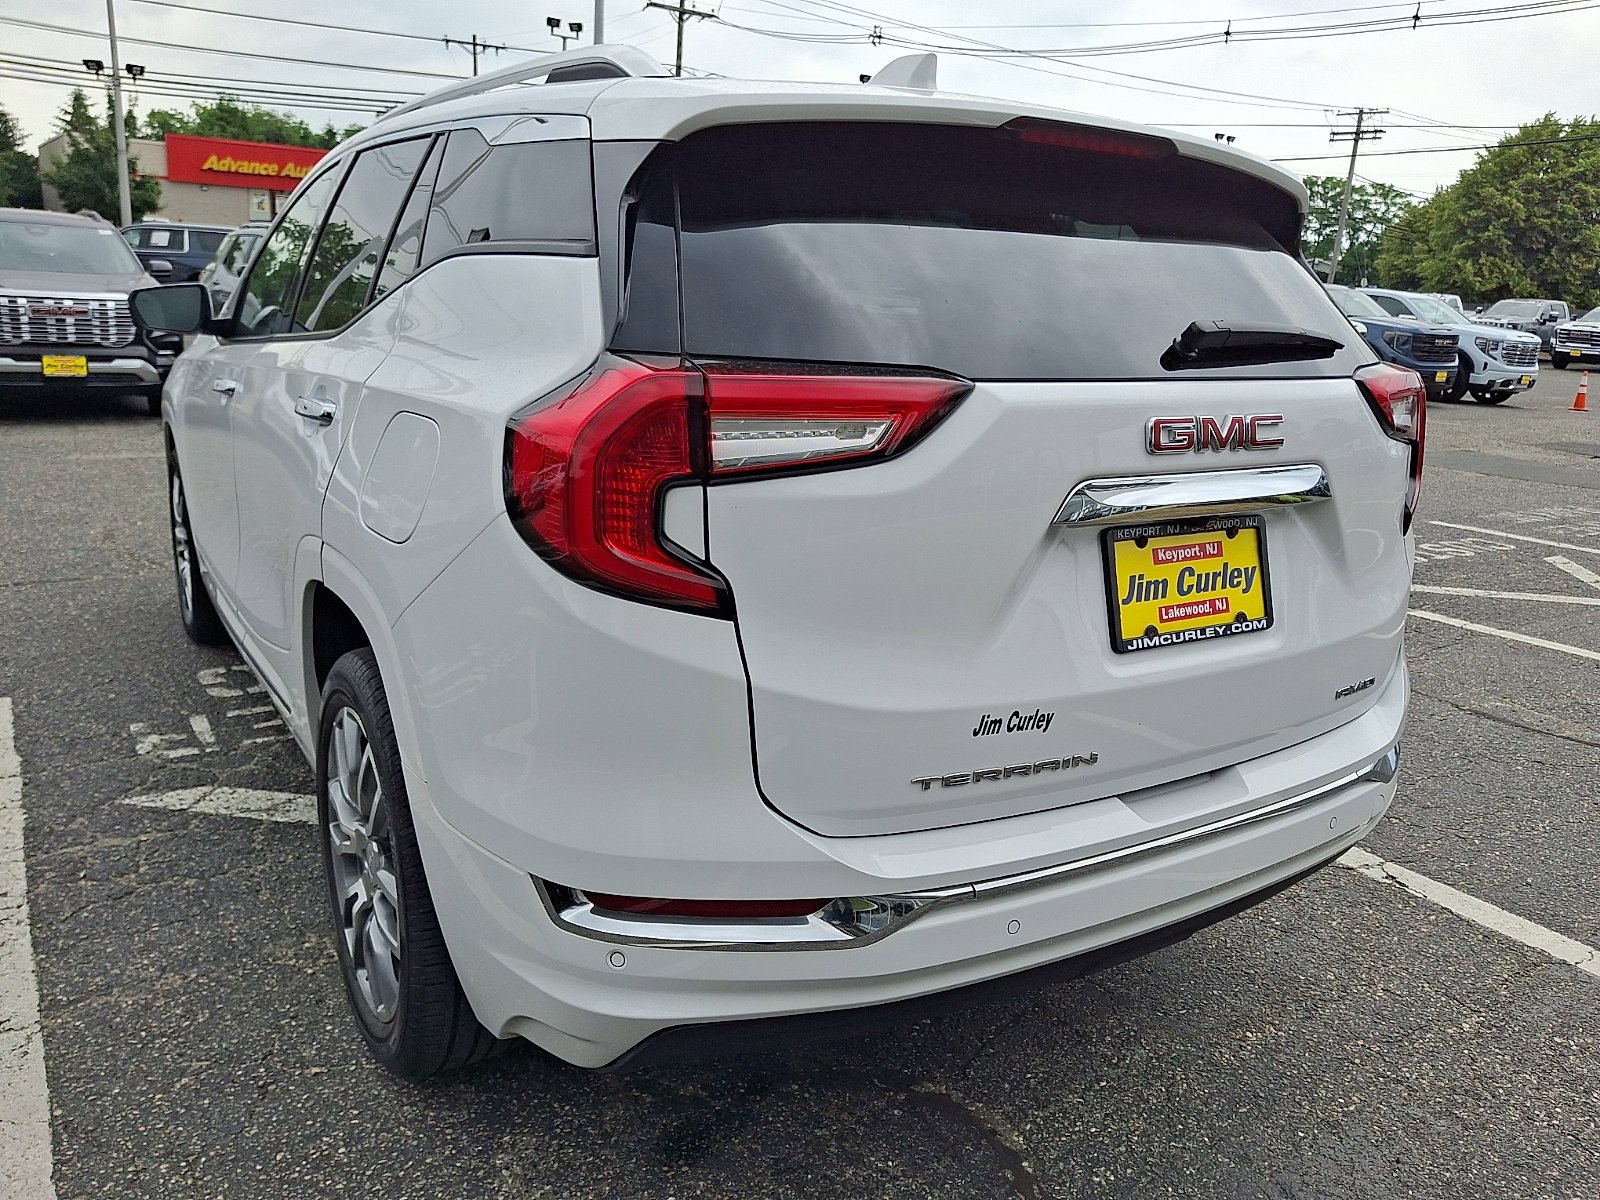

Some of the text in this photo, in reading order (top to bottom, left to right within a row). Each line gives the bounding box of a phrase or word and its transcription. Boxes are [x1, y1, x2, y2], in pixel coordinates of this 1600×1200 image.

[200, 155, 279, 176] Advance
[1145, 412, 1285, 455] GMC
[1117, 525, 1165, 539] KEYPORT,
[1167, 524, 1181, 534] NJ
[1245, 516, 1259, 527] NJ
[1157, 541, 1219, 563] Keyport, NJ
[1121, 561, 1257, 606] Jim Curley
[1161, 599, 1228, 620] Lakewood, NJ
[1127, 619, 1268, 651] JIMCURLEY.COM
[972, 708, 1055, 738] Jim Curley
[911, 751, 1099, 792] TERRAIN
